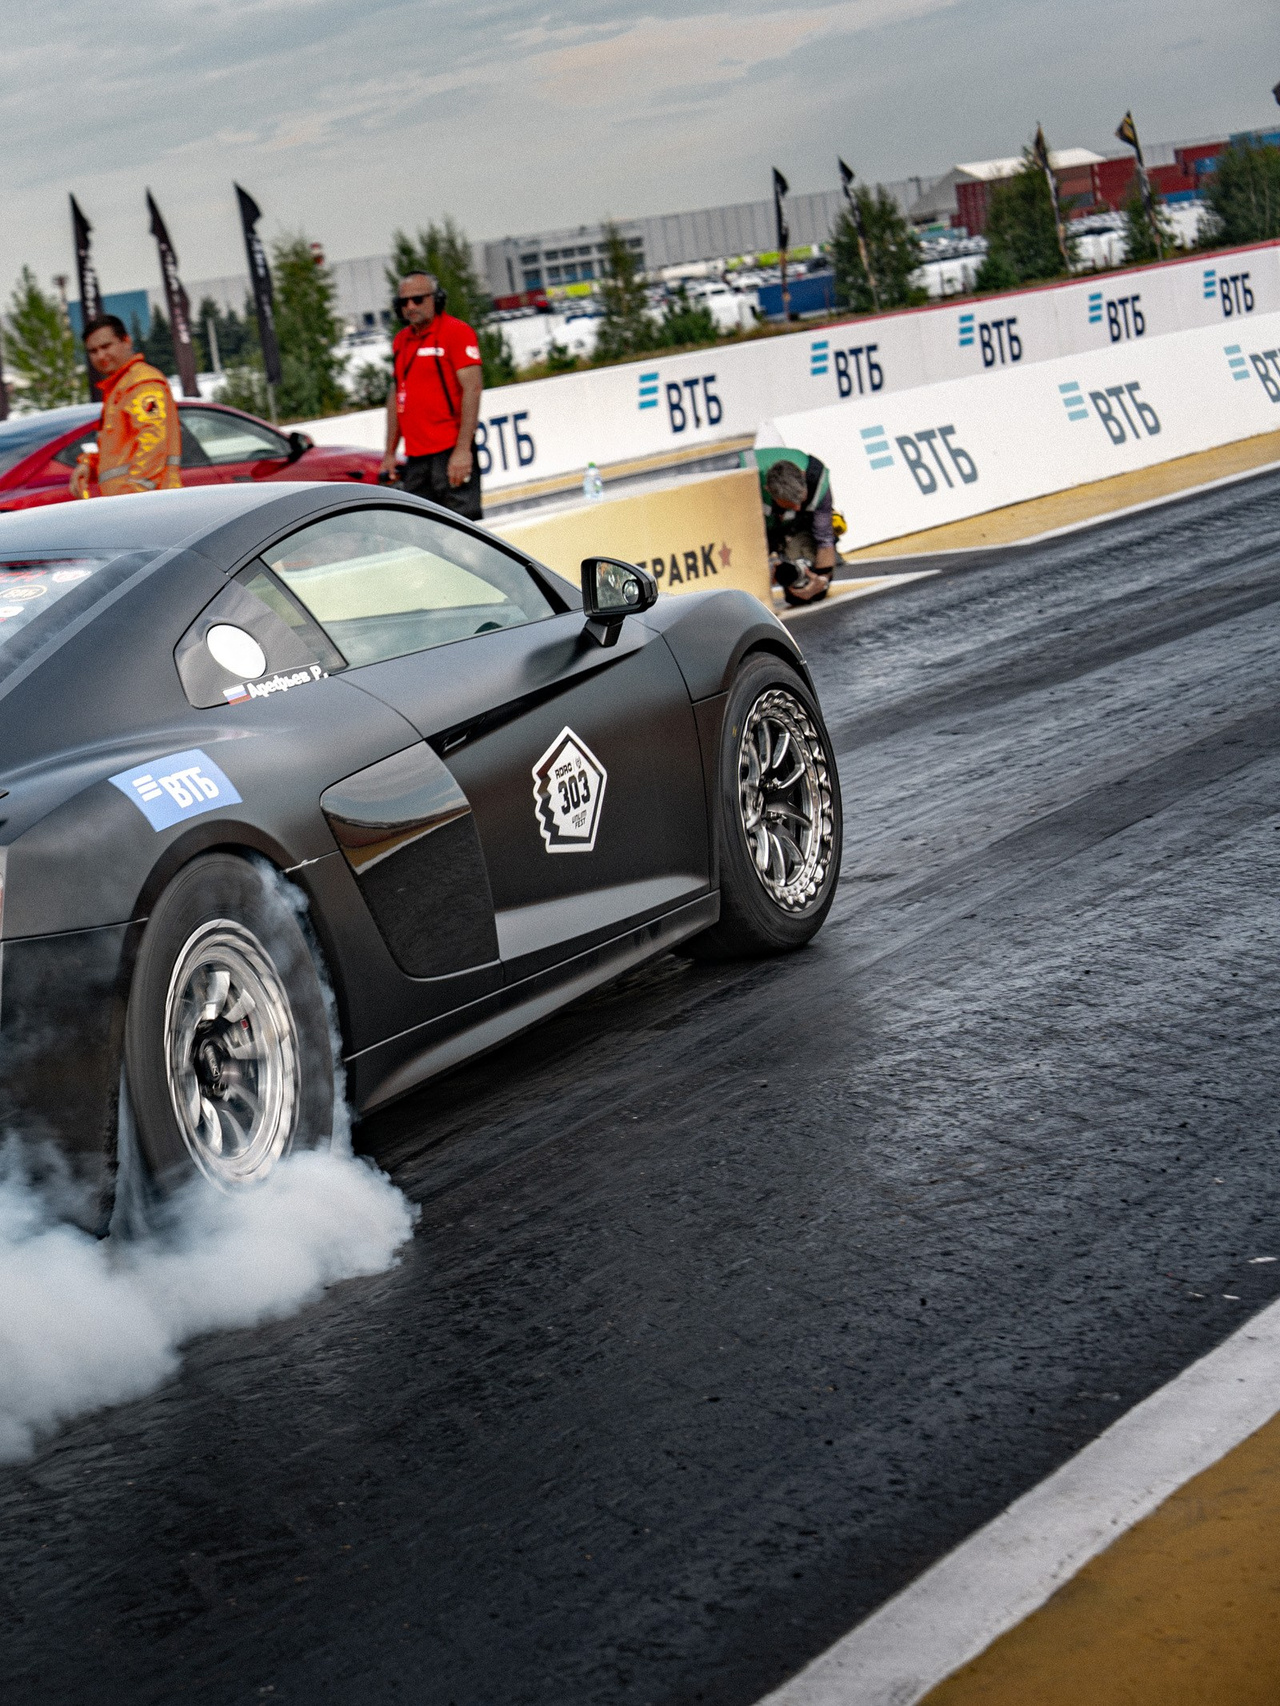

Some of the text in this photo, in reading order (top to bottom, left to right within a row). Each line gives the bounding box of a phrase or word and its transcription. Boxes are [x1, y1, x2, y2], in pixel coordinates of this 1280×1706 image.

[1106, 294, 1146, 343] ВТБ
[1220, 272, 1254, 317] ВТБ
[979, 317, 1022, 368] ВТБ
[834, 343, 884, 398] ВТБ
[1249, 348, 1280, 403] ВТ
[665, 374, 723, 434] ВТБ
[1089, 381, 1161, 445] ВТБ
[475, 410, 536, 476] ВТБ
[895, 425, 979, 495] ВТБ
[635, 541, 718, 588] PARK
[157, 766, 219, 808] ВТБ
[557, 769, 591, 816] 303
